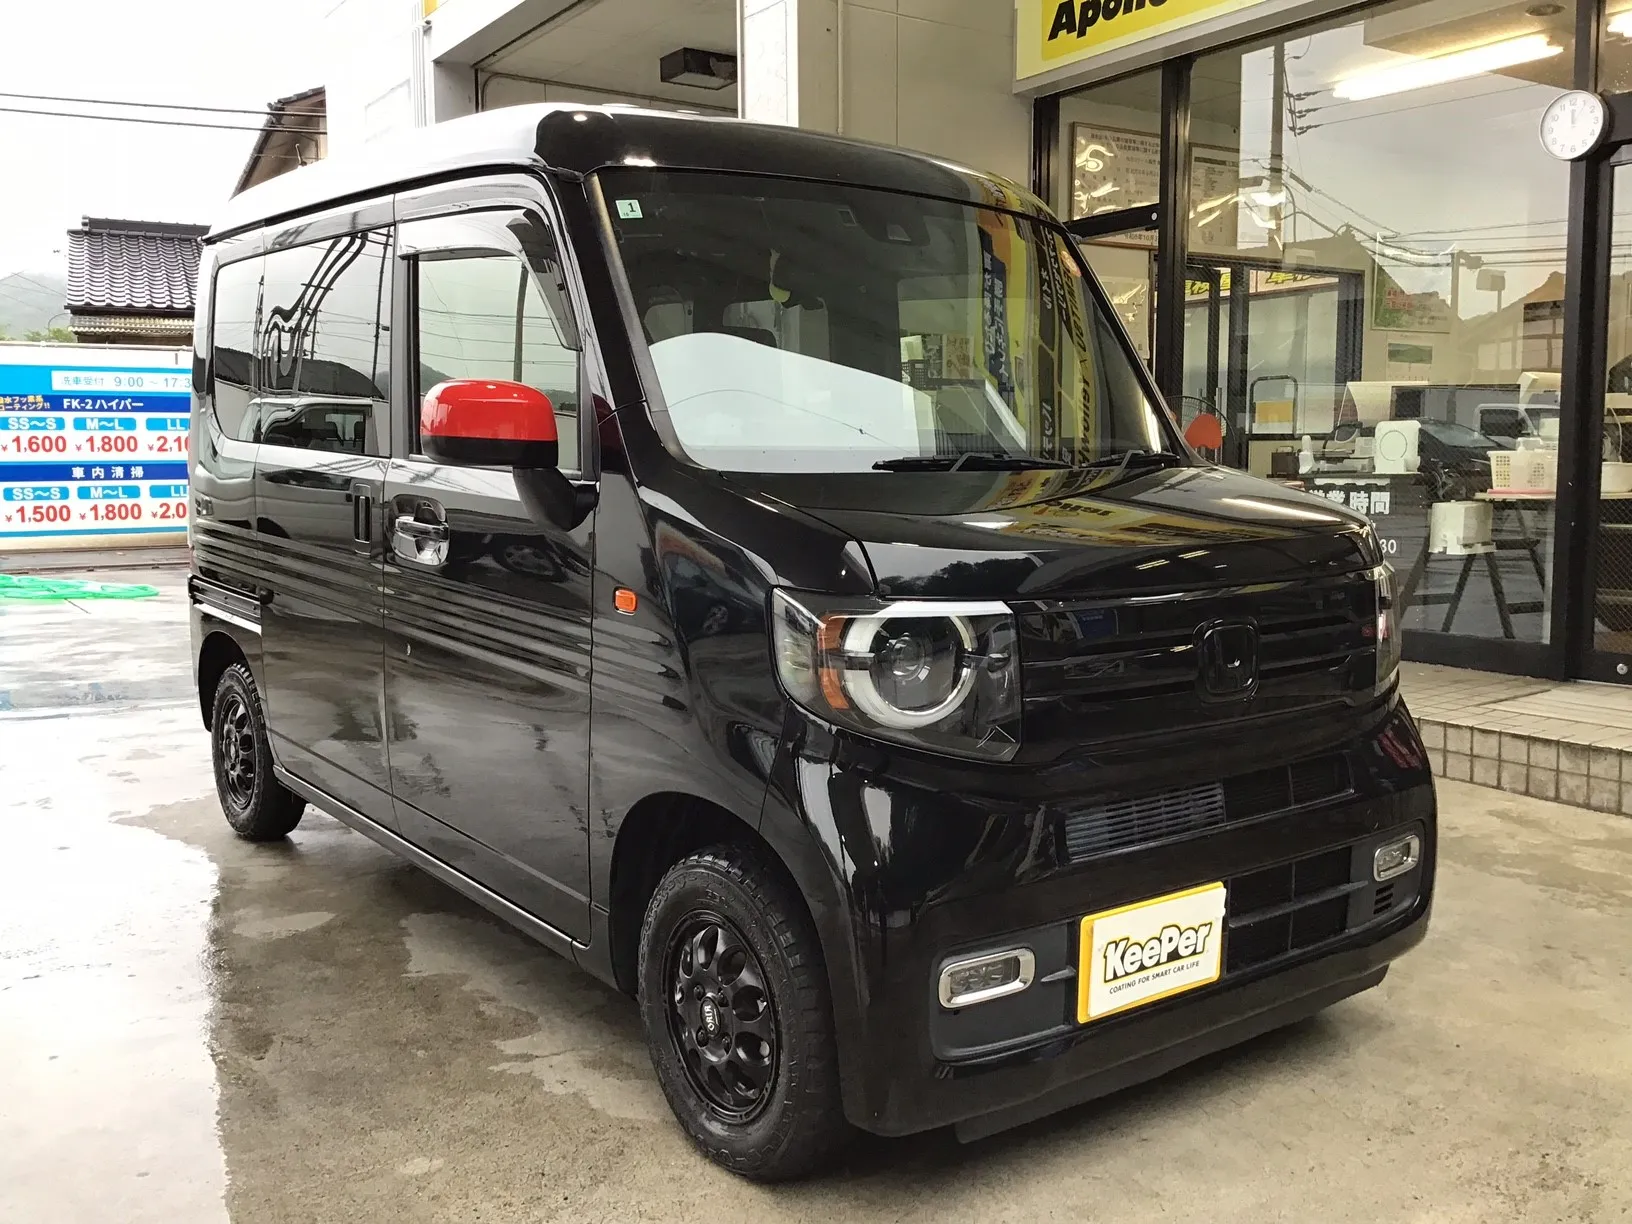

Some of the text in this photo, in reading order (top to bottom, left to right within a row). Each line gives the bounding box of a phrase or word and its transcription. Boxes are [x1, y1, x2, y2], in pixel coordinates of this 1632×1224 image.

[1570, 98, 1577, 106] 12
[1589, 105, 1595, 113] 2
[628, 202, 636, 212] 1
[115, 377, 144, 387] 9:00
[72, 466, 144, 479] 車内清掃
[1104, 922, 1212, 983] KeePer
[1109, 960, 1200, 995] COATING FOR SMART CAR LIFE
